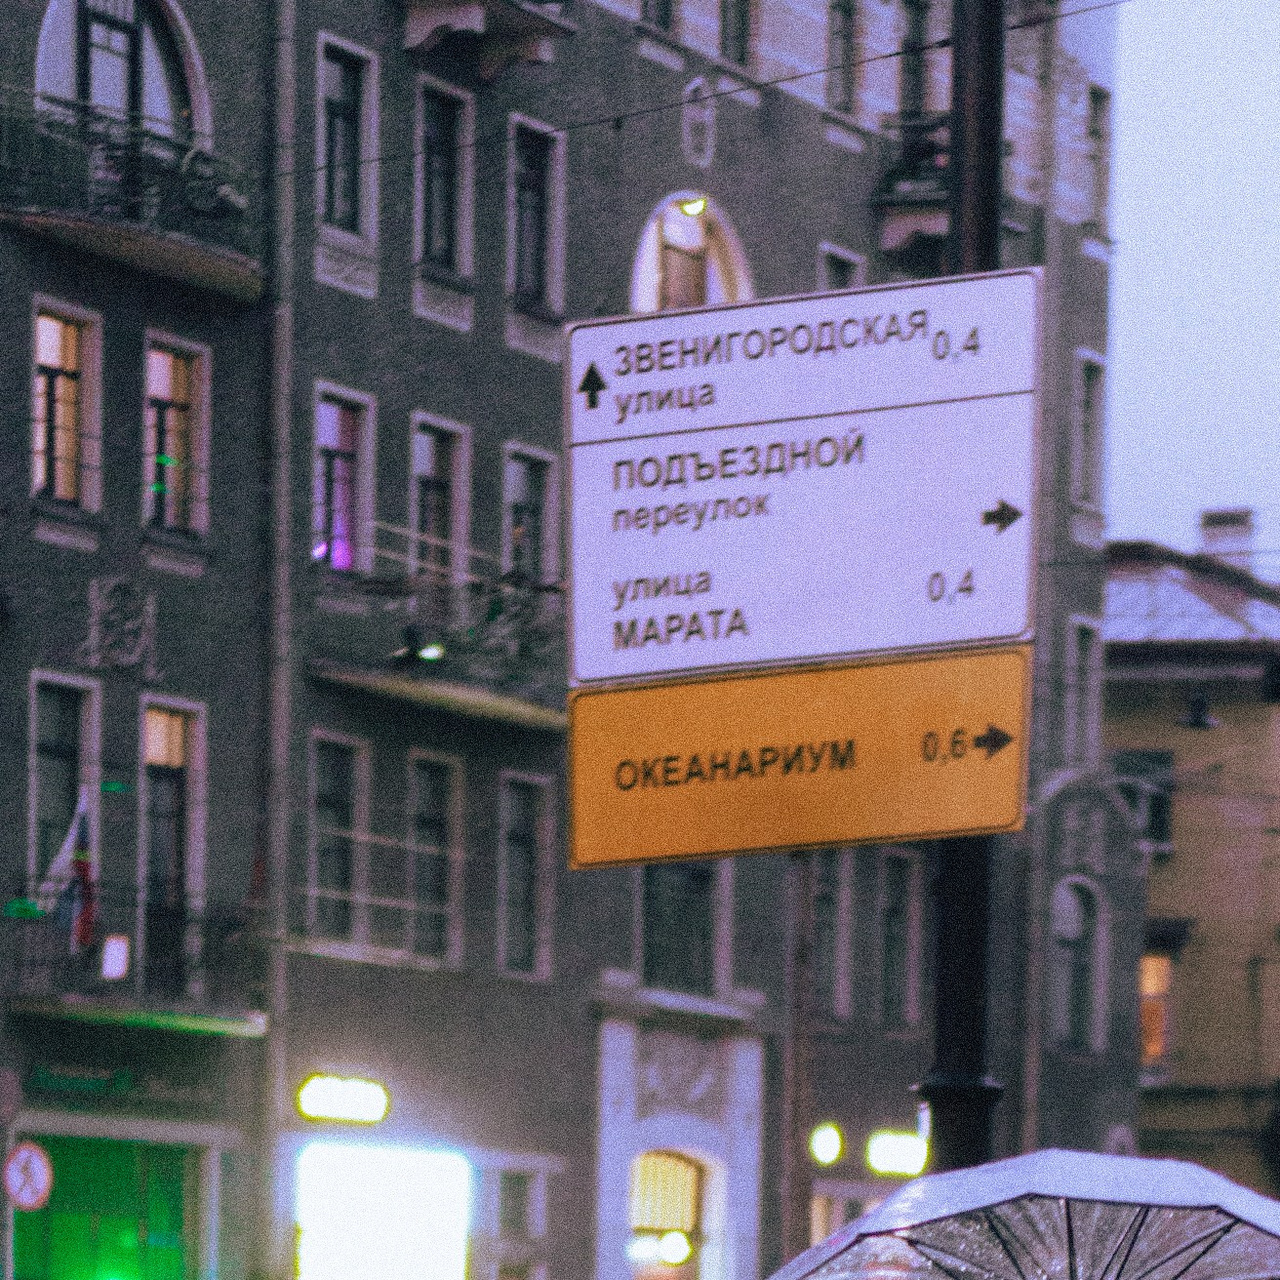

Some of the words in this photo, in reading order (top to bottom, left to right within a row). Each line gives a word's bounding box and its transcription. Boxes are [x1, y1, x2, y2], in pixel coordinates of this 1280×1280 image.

[614, 309, 928, 375] ЗВЕНИГОРОДСКАЯ
[614, 382, 716, 424] улица
[613, 428, 864, 491] ПОДЪЕЗДНОЙ
[612, 495, 769, 535] переулок
[612, 571, 711, 611] улица
[612, 608, 748, 650] МАРАТА
[615, 739, 855, 791] ОКЕАНАРИУМ
